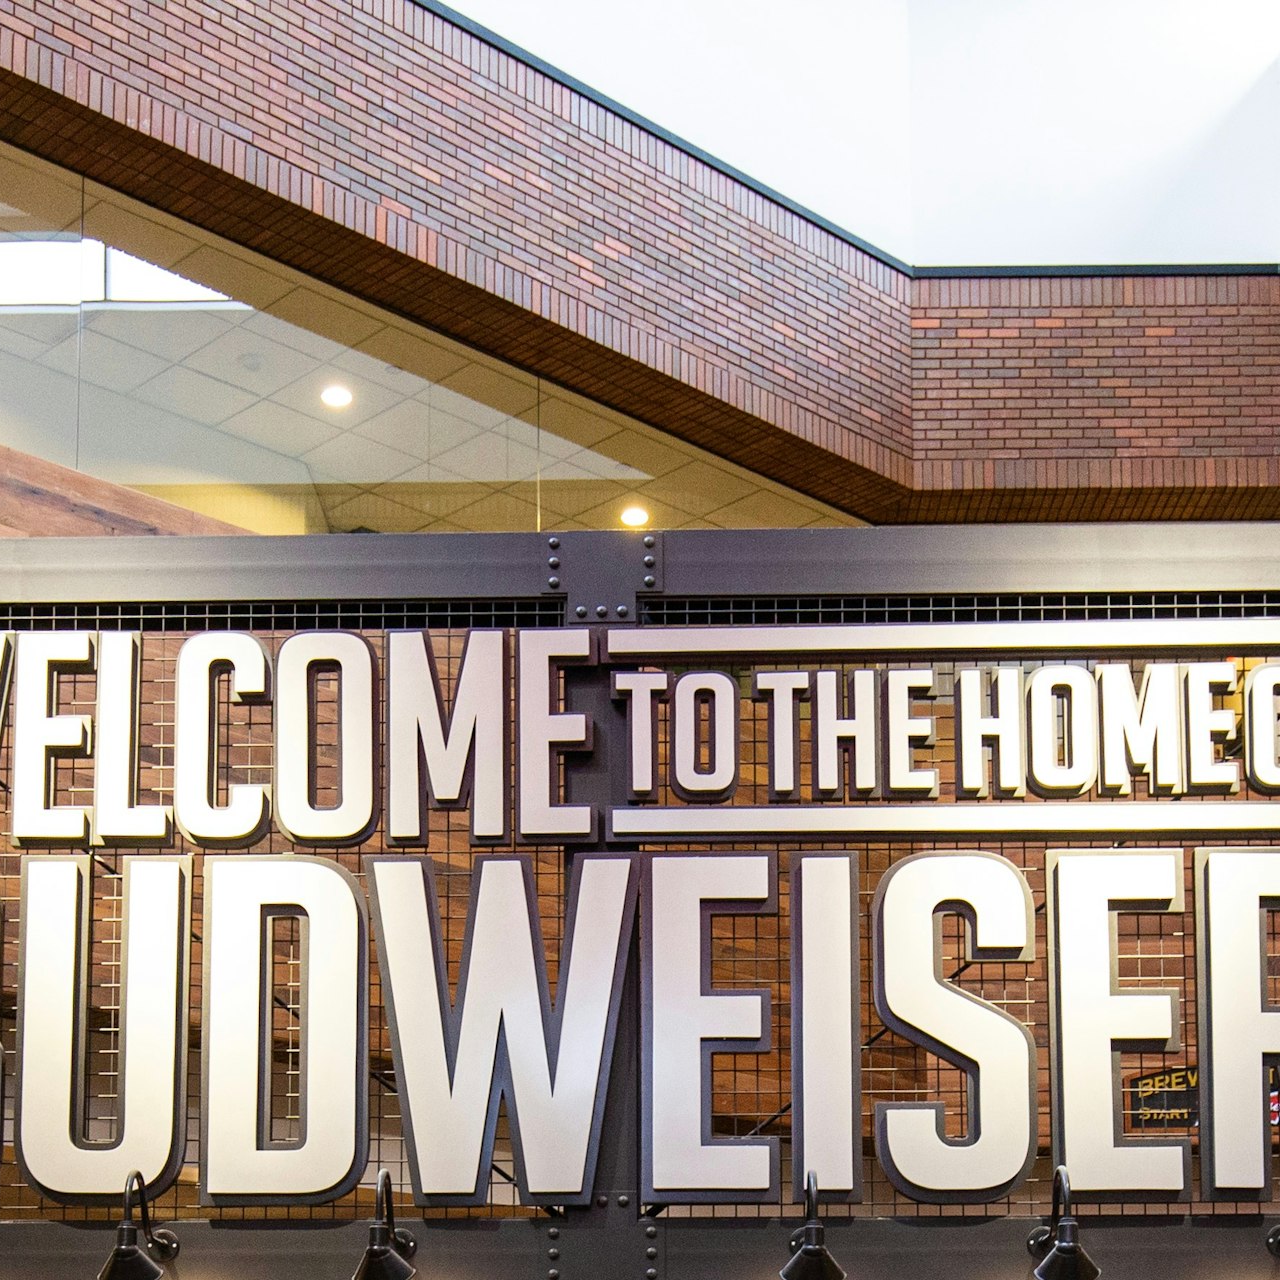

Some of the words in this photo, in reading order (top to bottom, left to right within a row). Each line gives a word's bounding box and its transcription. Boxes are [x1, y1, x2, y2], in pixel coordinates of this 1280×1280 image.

[613, 672, 736, 793] TO
[757, 669, 940, 792] THE
[960, 664, 1239, 793] HOME
